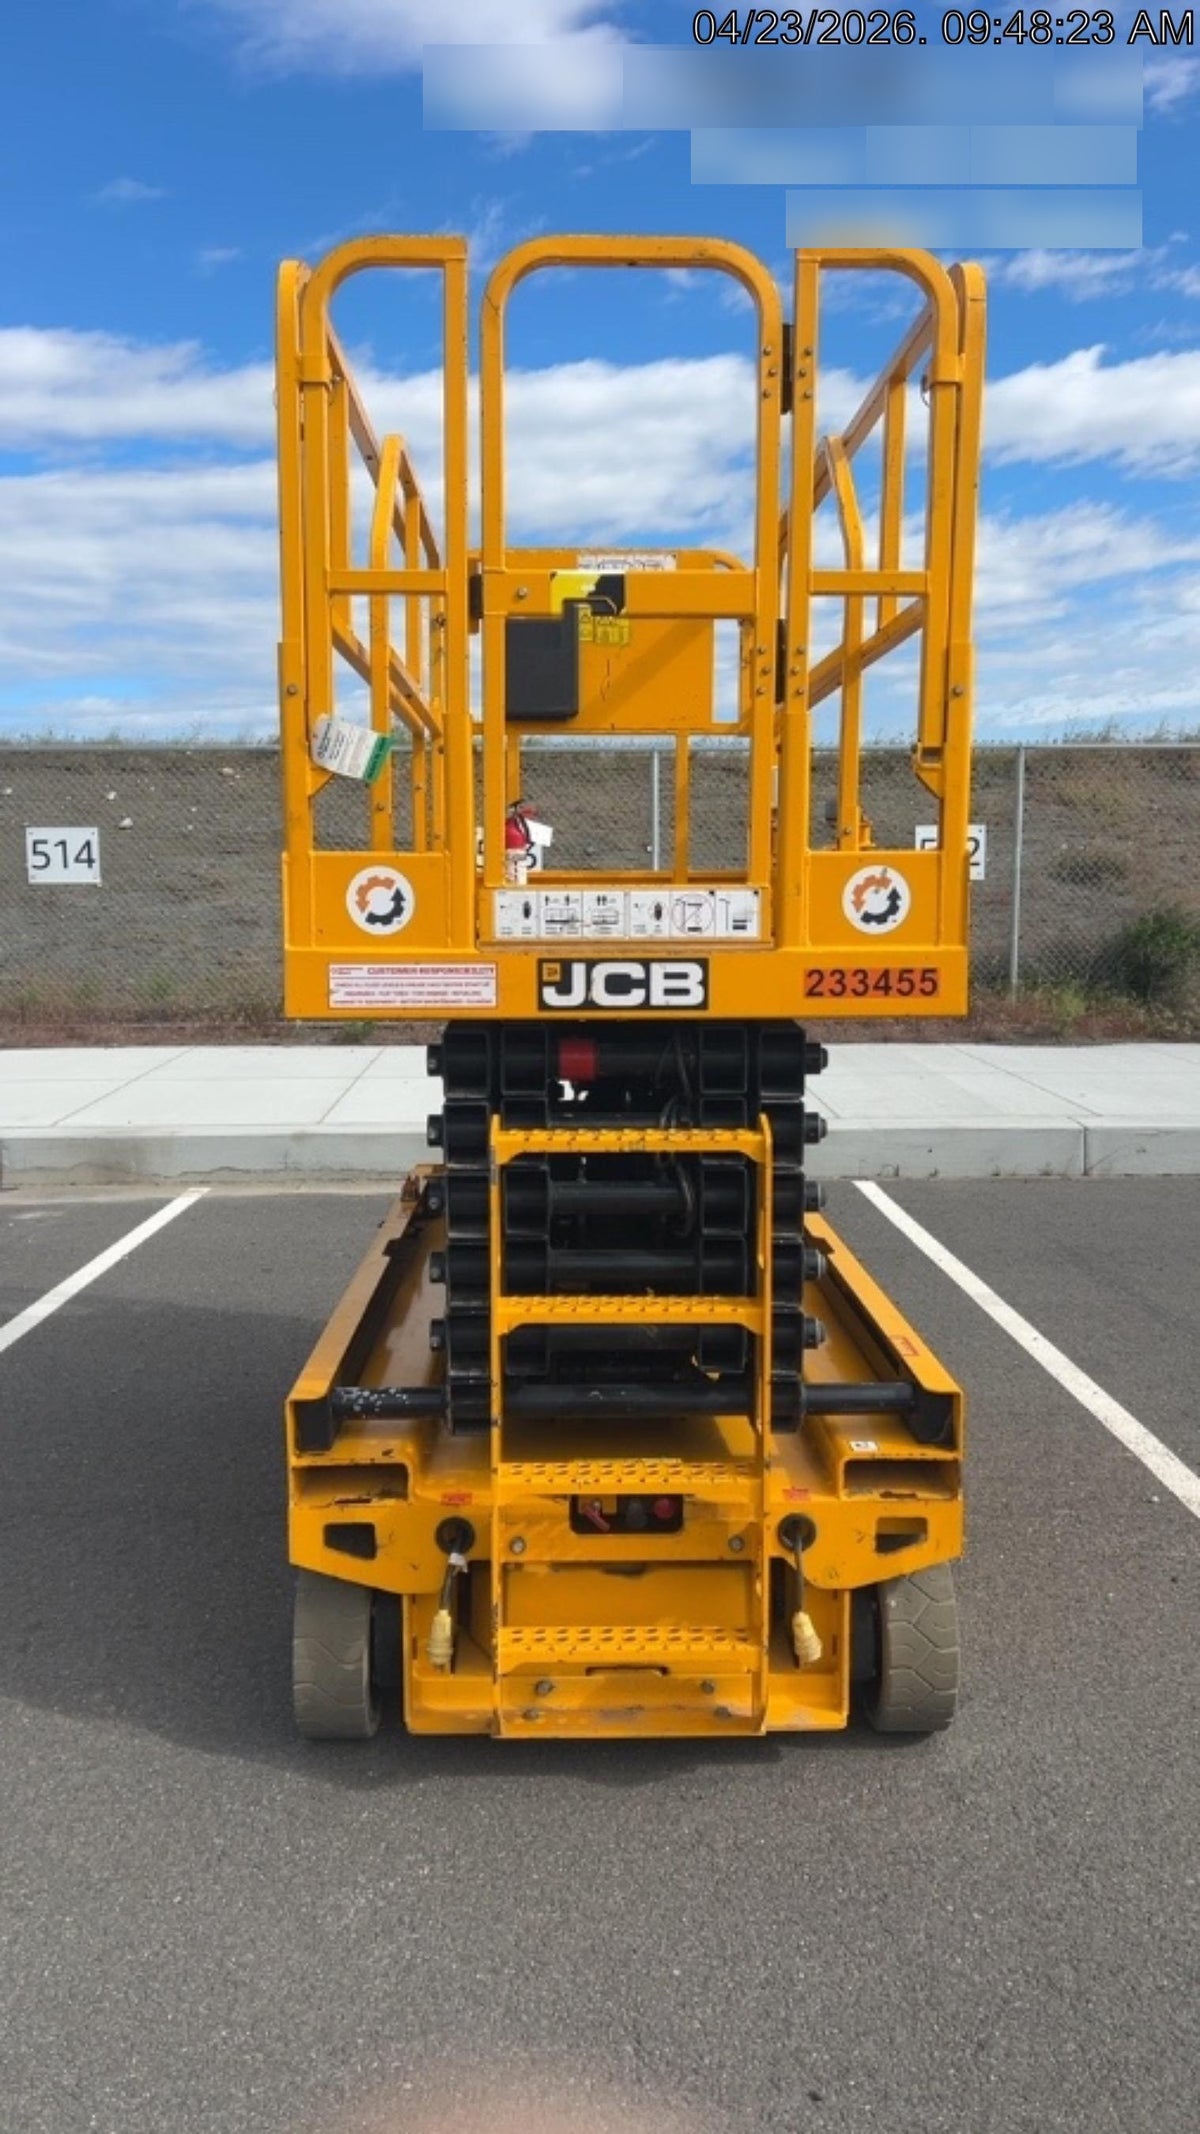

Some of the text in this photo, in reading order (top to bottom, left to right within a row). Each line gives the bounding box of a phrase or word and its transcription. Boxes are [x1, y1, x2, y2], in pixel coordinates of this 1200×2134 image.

[31, 839, 96, 870] 514
[542, 962, 705, 1007] JCB
[805, 968, 938, 997] 233455
